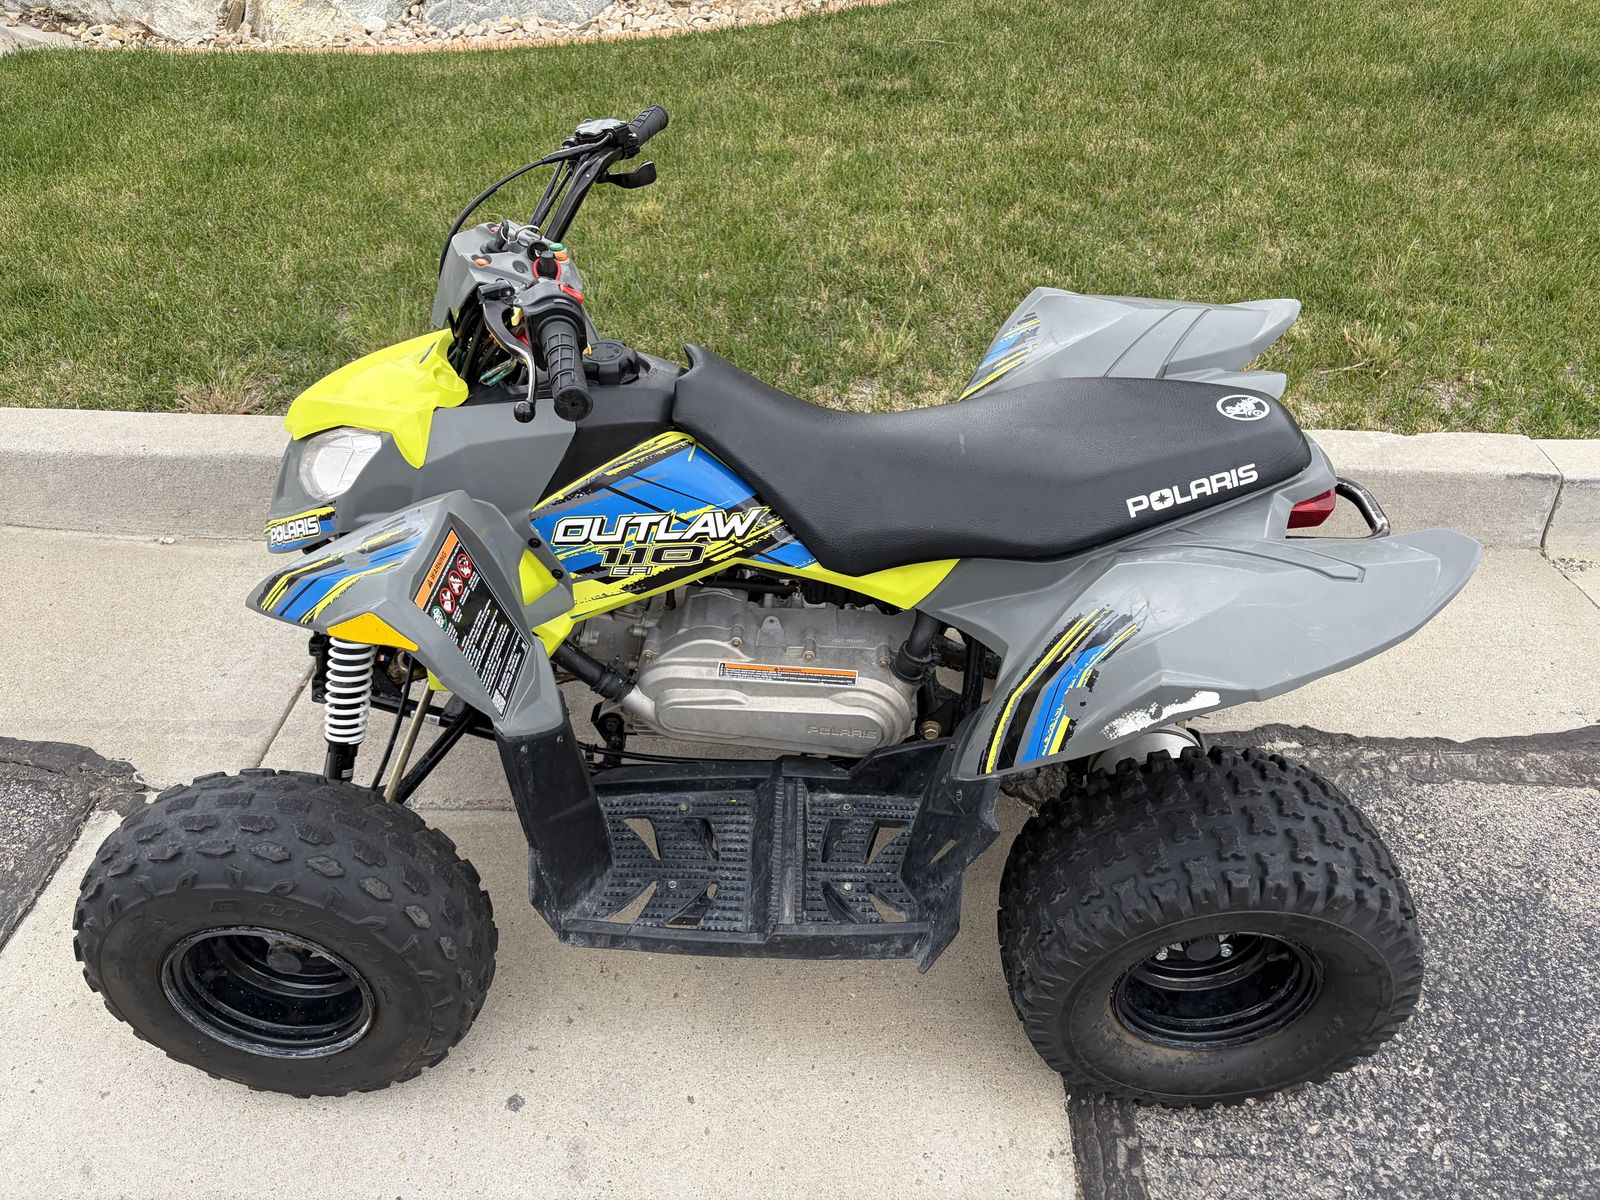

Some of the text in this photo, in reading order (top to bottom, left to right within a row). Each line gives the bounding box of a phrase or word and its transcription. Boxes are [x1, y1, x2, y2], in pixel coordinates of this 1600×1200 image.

[1126, 463, 1259, 519] POLARIS
[270, 516, 320, 546] POLARIS
[552, 507, 769, 545] OUTLAW
[430, 550, 447, 580] WARNING
[600, 545, 706, 567] 110
[610, 566, 653, 576] EFI
[807, 726, 879, 739] POLARIS
